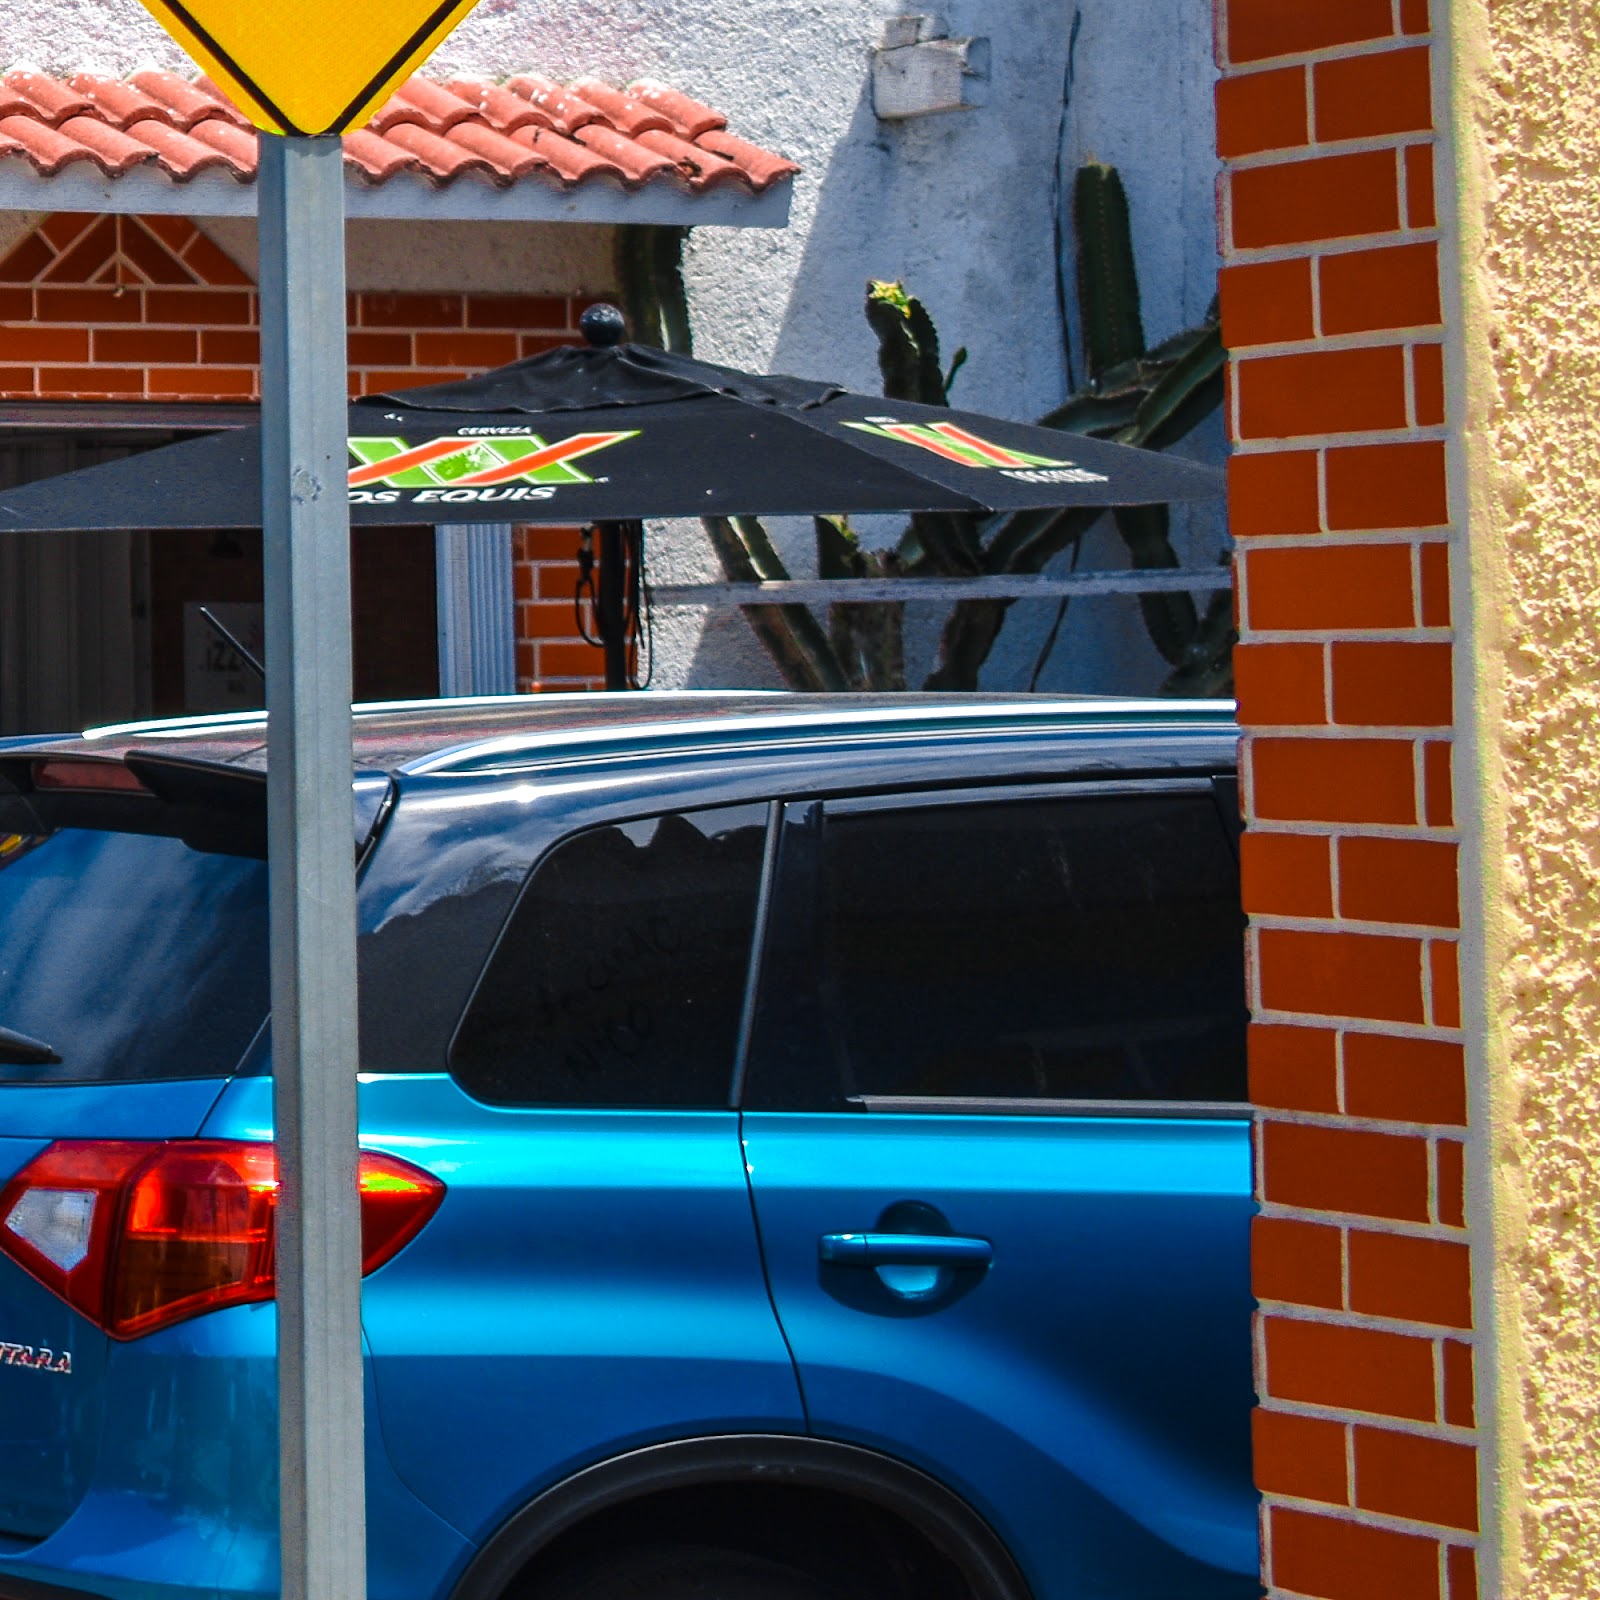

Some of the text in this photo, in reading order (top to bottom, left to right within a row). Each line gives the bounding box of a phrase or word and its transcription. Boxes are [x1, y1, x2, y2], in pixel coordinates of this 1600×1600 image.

[457, 426, 532, 435] CERVEZA
[347, 486, 558, 505] OS EQUIS
